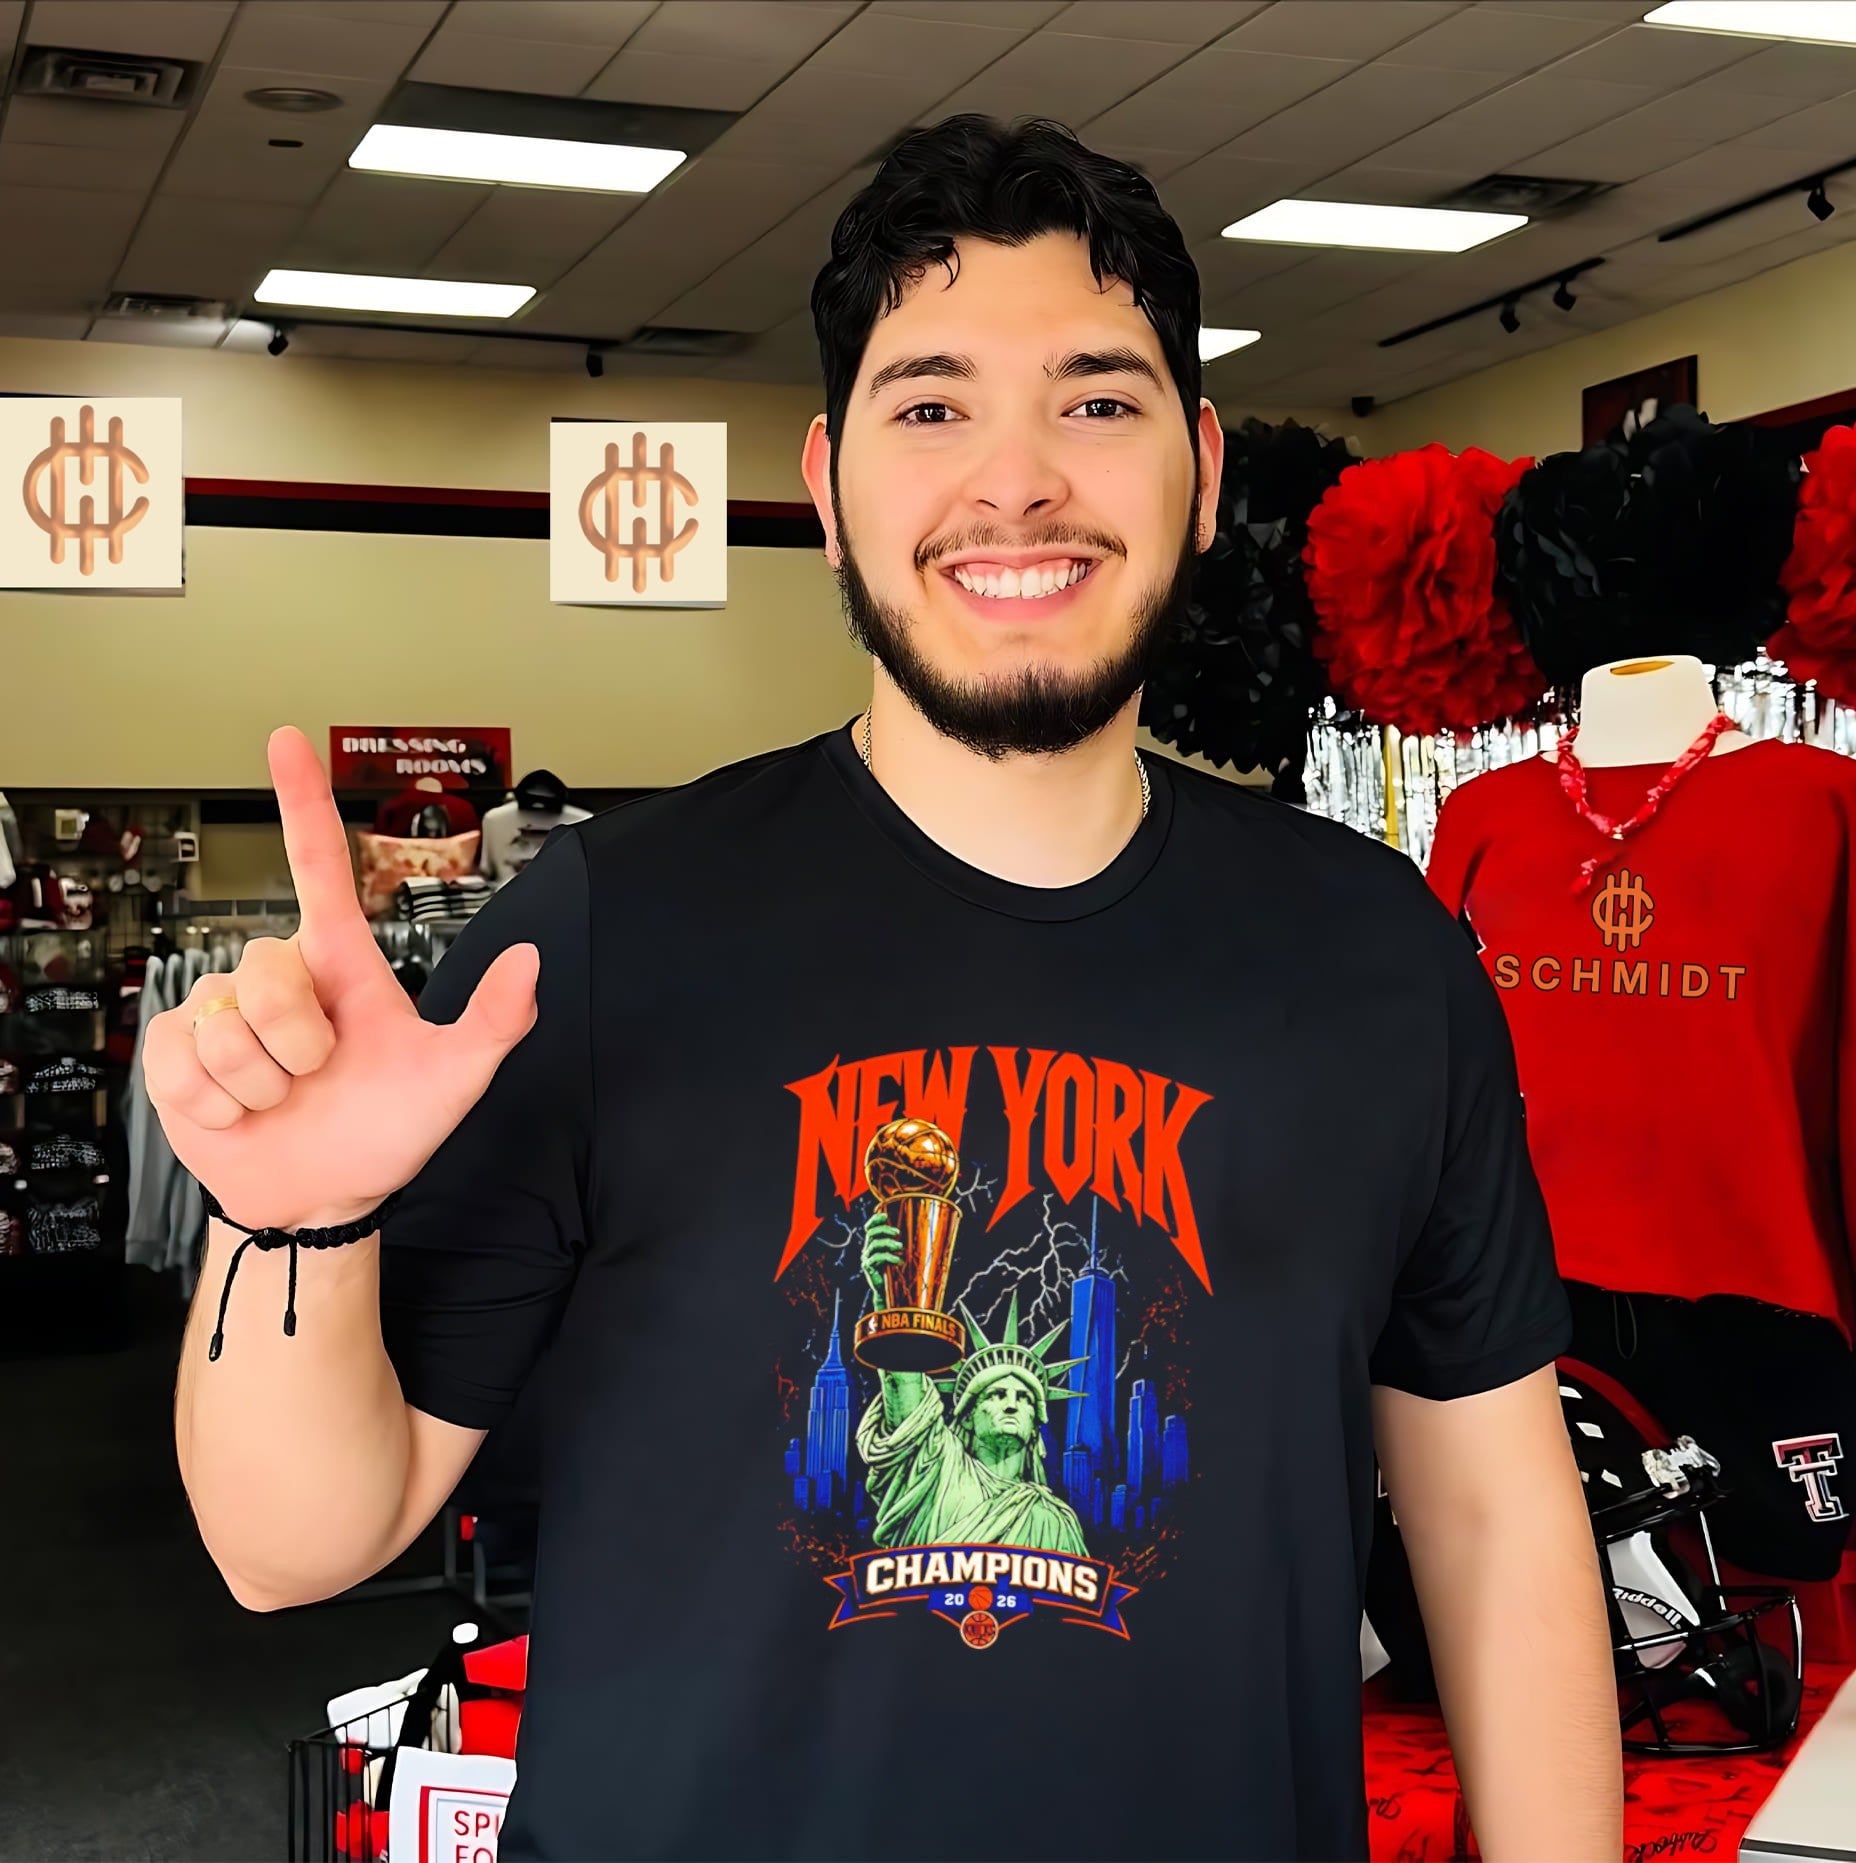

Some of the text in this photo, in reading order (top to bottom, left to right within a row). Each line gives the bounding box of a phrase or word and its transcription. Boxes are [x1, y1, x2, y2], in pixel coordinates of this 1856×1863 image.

[396, 758, 487, 775] ROOMS
[1494, 953, 1747, 1000] SCHMIDT
[773, 1046, 1216, 1297] NEW YORK
[881, 1313, 957, 1338] NBA FINALS
[865, 1551, 1099, 1602] CHAMPIONS
[944, 1593, 1017, 1608] 20 26
